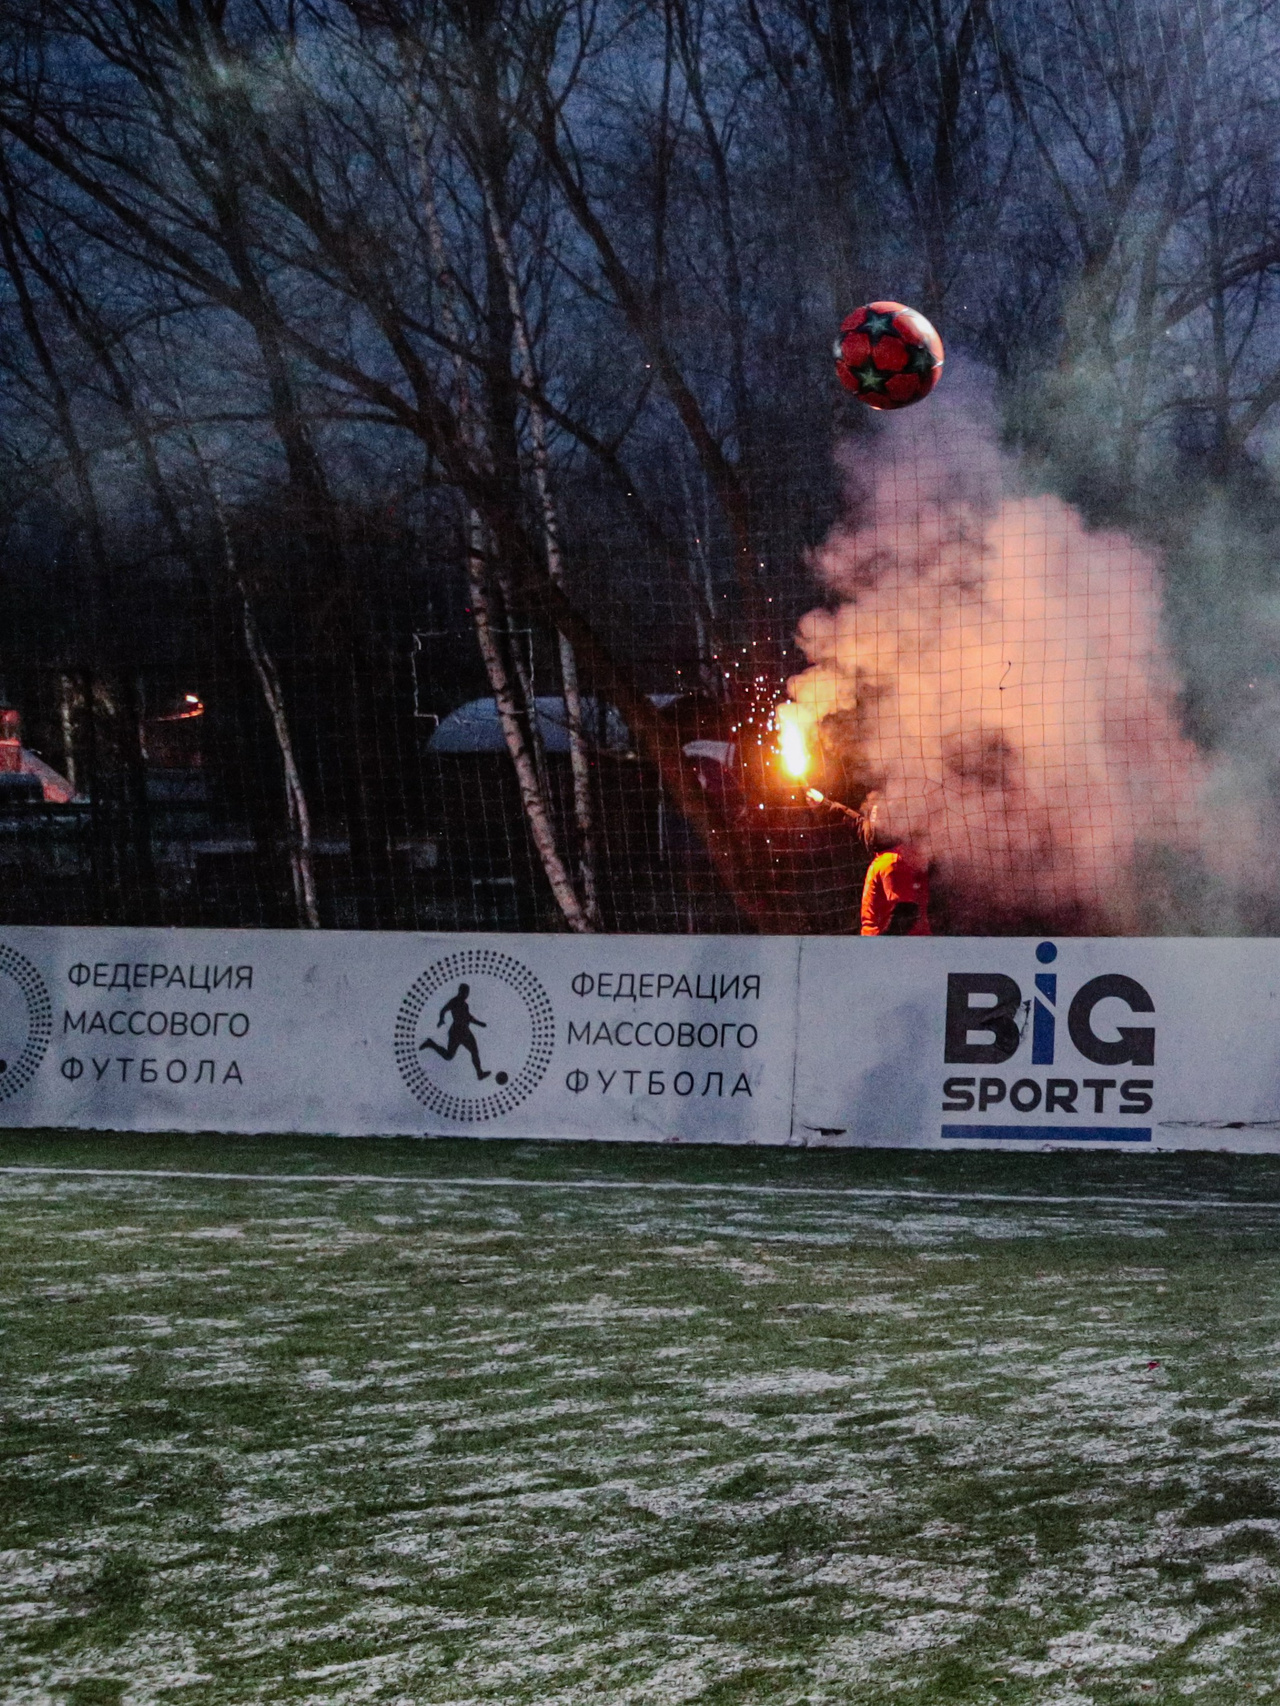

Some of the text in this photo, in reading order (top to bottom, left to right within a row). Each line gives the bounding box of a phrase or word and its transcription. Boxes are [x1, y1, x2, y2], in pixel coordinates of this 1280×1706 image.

[67, 962, 254, 993] ФЕДЕРАЦИЯ
[570, 971, 761, 1004] ФЕДЕРАЦИЯ
[62, 1009, 250, 1038] МАССОВОГО
[567, 1020, 759, 1050] МАССОВОГО
[60, 1055, 243, 1086] ФУТБОЛА
[565, 1068, 753, 1098] ФУТБОЛА
[941, 1077, 1154, 1114] SPORTS
